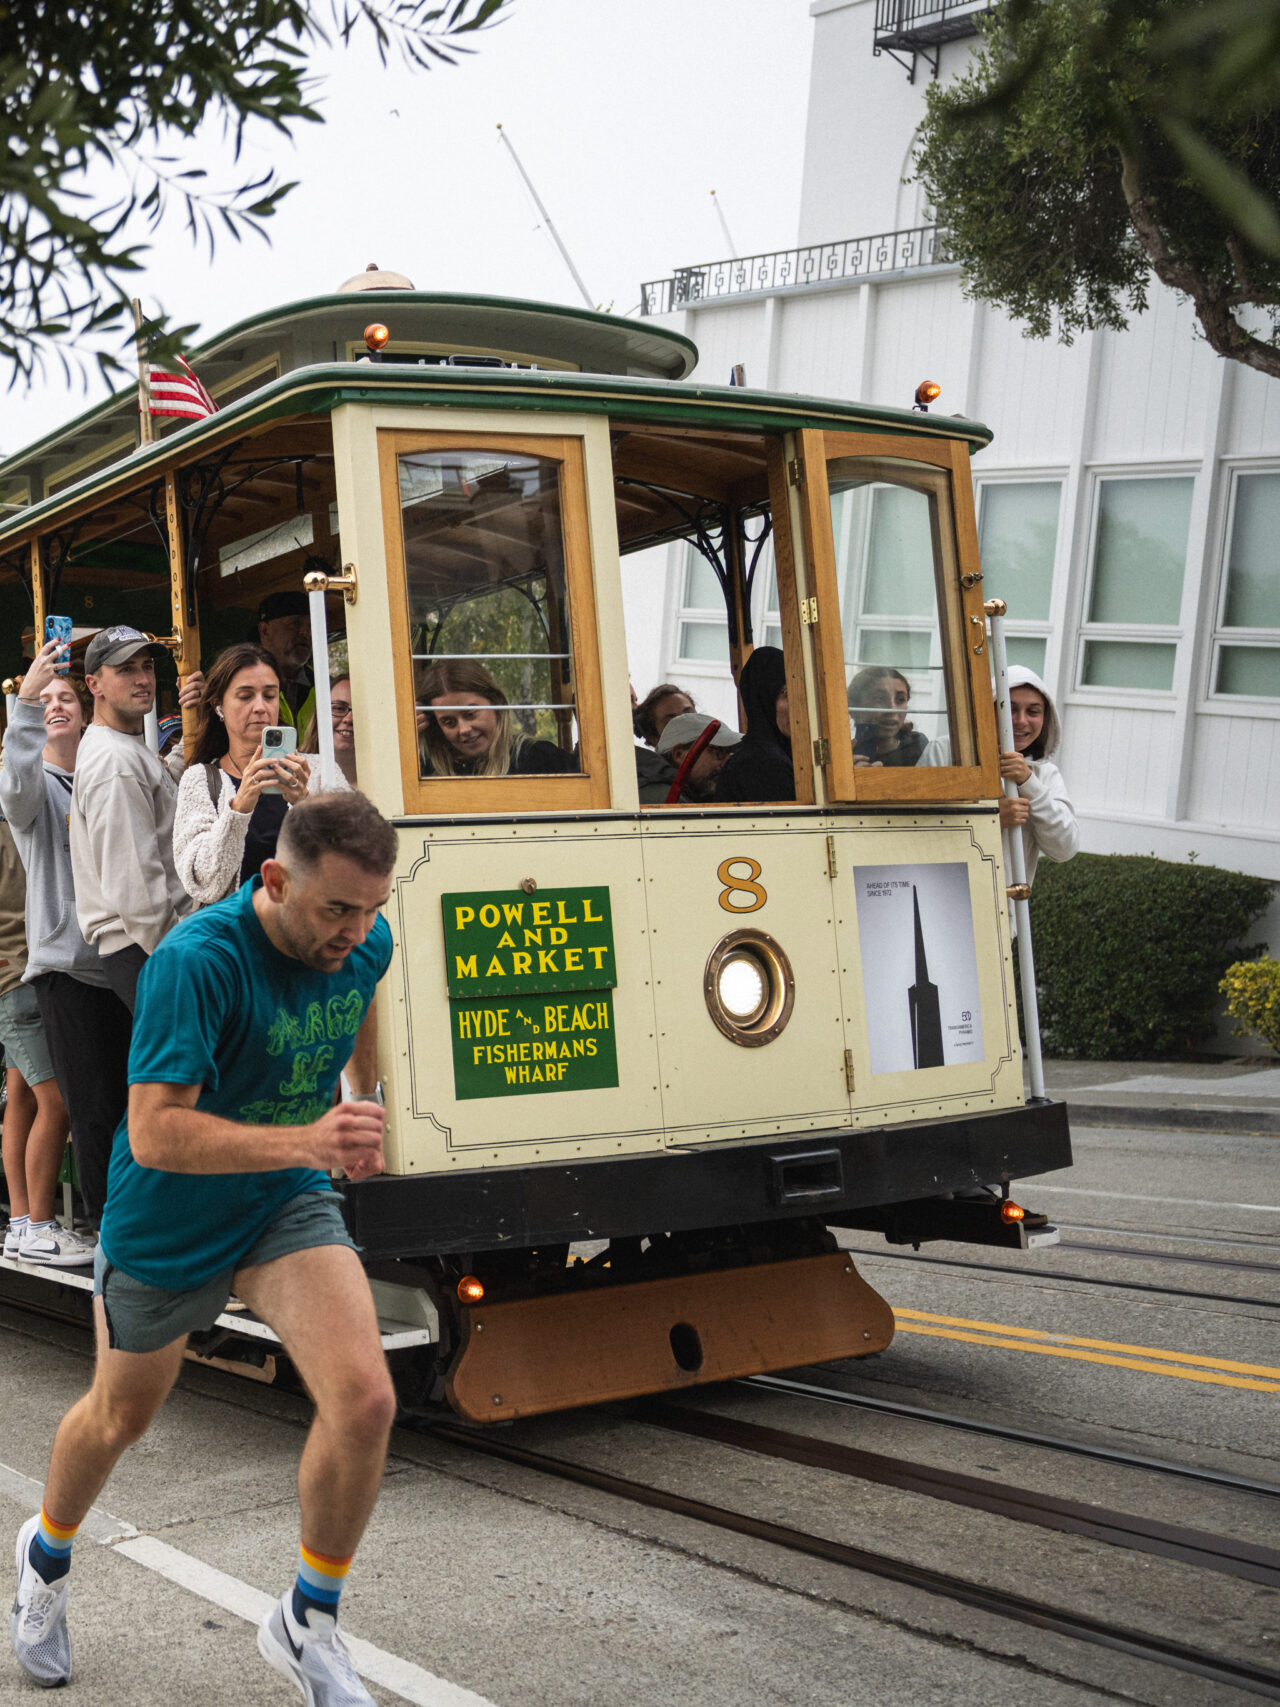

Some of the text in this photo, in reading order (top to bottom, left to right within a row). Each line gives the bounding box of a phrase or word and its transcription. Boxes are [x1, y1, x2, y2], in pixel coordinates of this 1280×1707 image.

[716, 856, 768, 914] 8
[455, 899, 603, 931] POWELL
[496, 927, 568, 949] AND
[455, 946, 608, 979] MARKET
[458, 1002, 610, 1039] HYDE AND BEACH
[472, 1038, 598, 1065] FISHERMANS
[504, 1062, 569, 1085] WHARF
